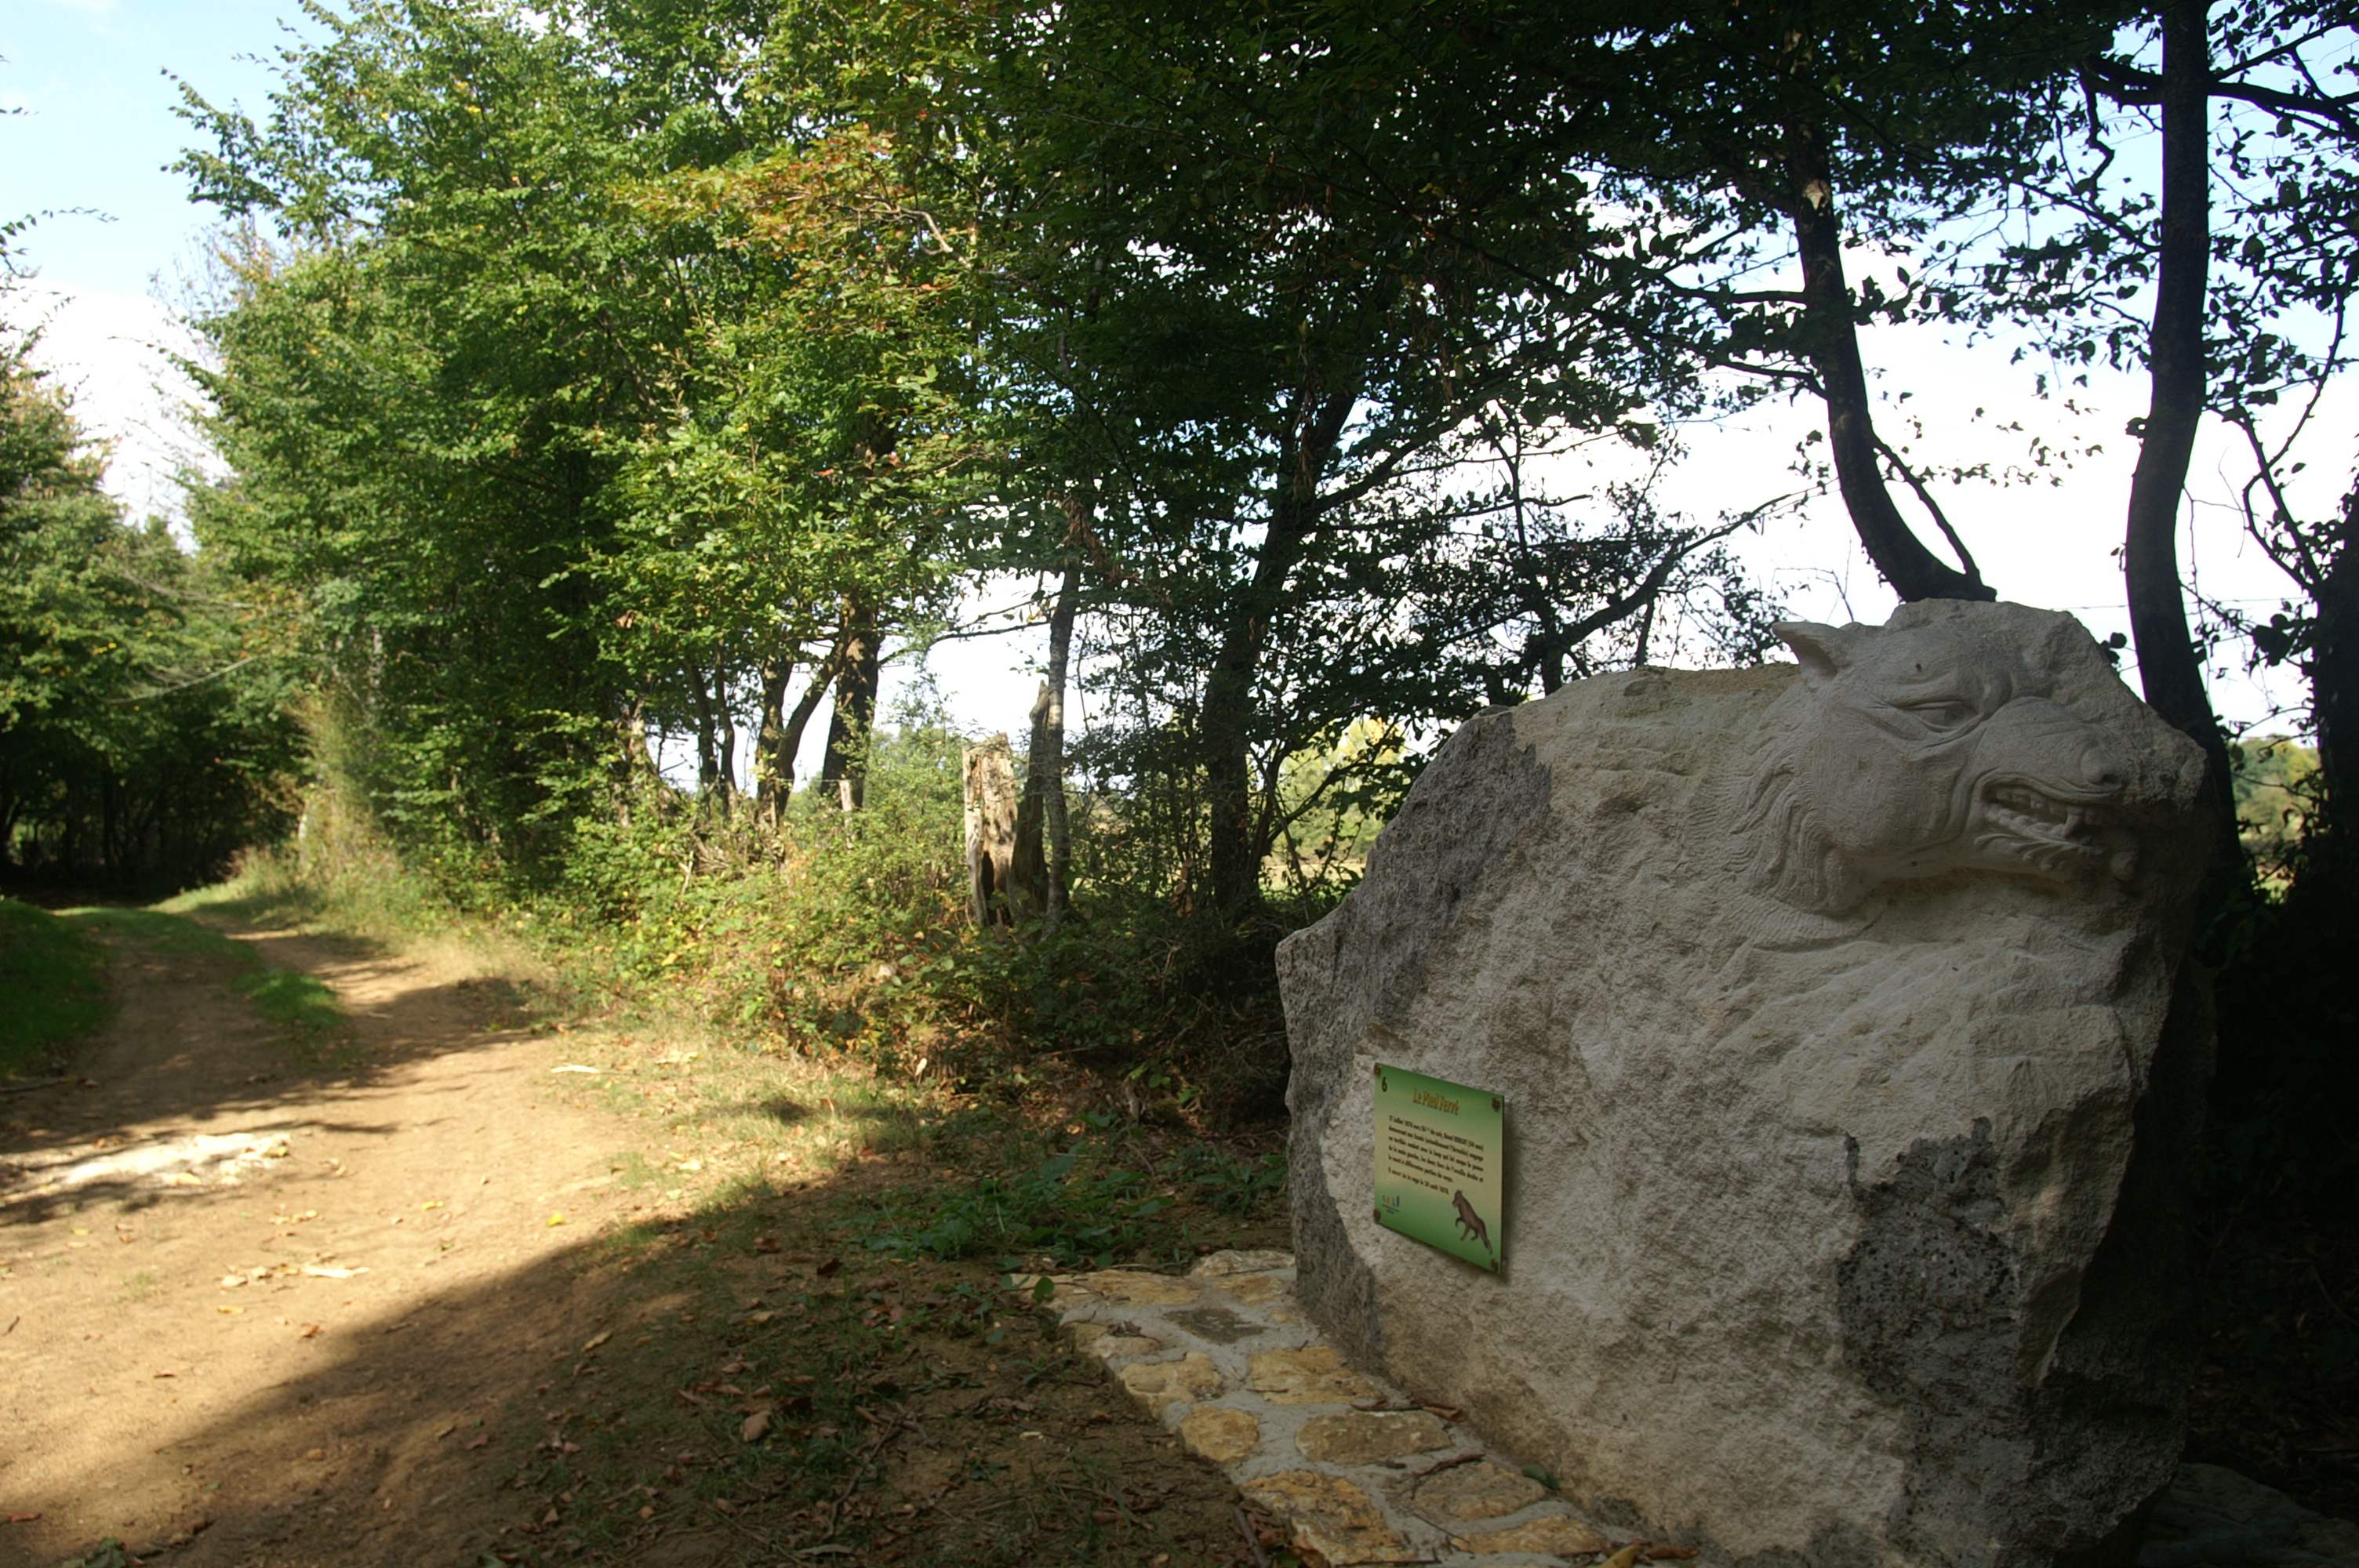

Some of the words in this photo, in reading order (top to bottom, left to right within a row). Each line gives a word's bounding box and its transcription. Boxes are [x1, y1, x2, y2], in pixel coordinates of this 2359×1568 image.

[1382, 1076, 1387, 1093] 6
[1412, 1088, 1421, 1105] Le
[1423, 1091, 1438, 1109] Pied
